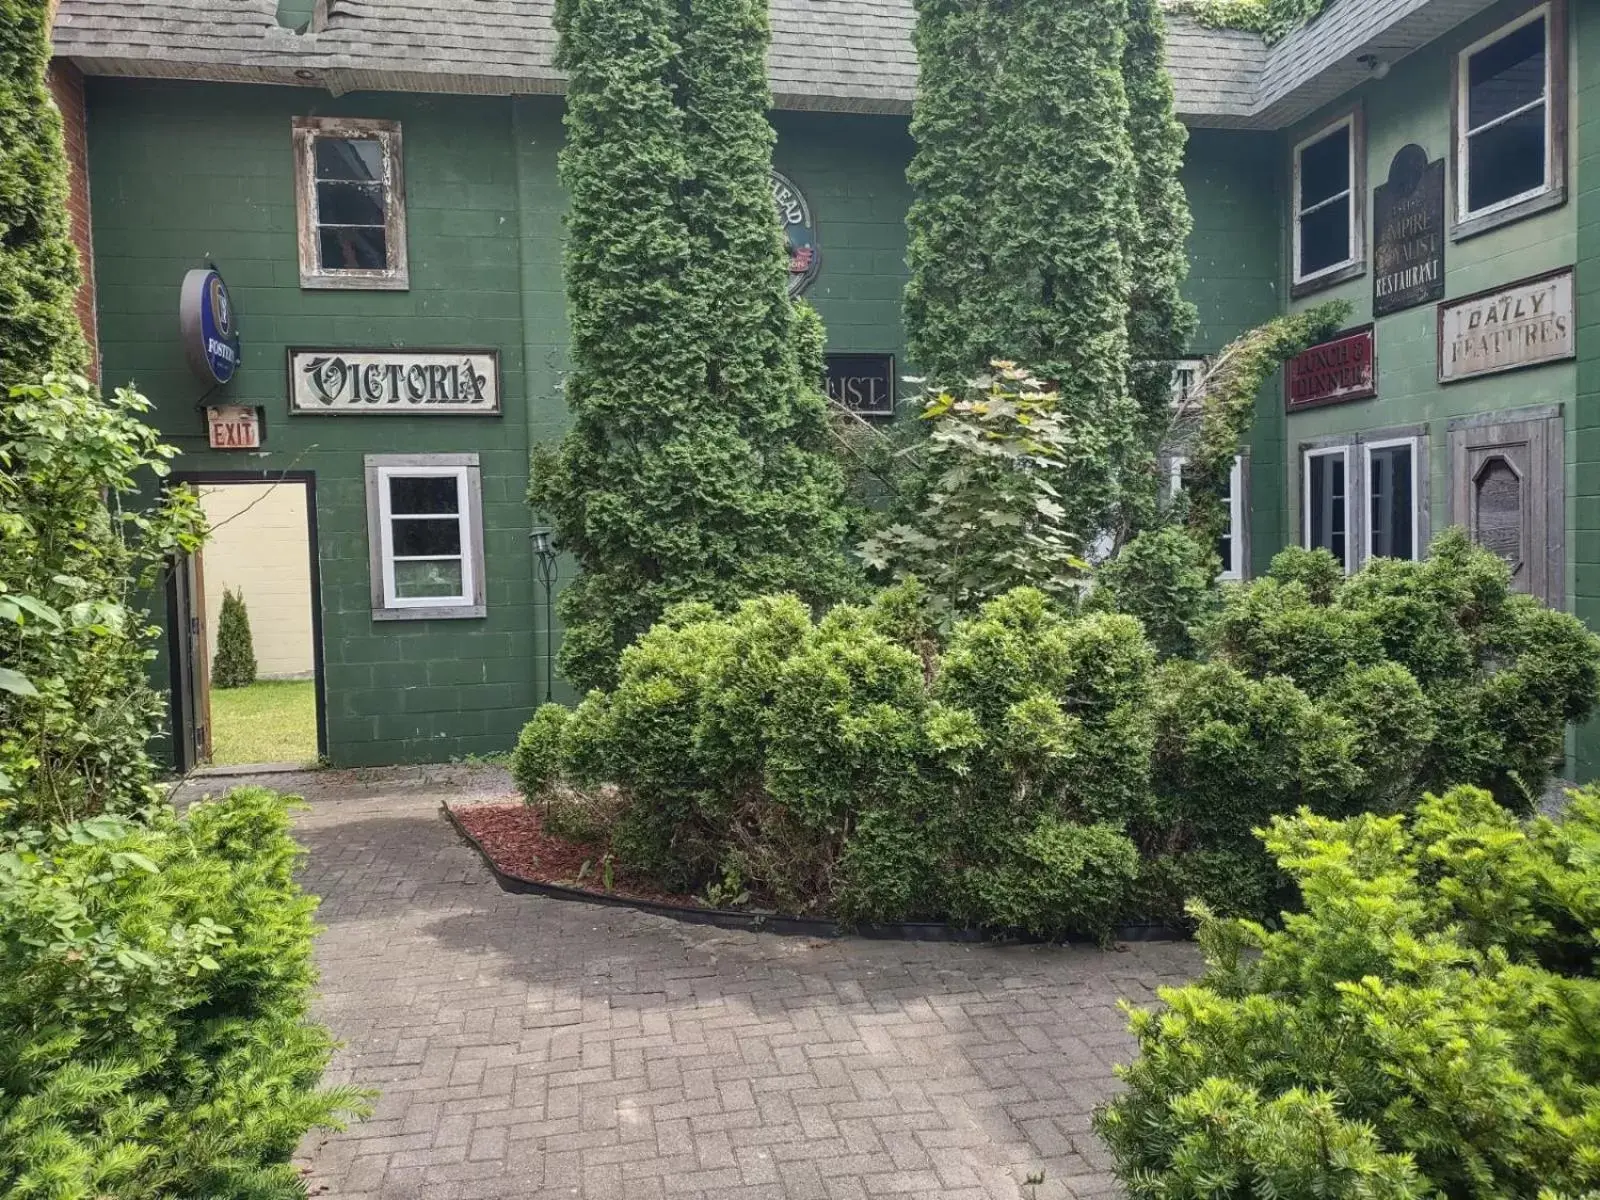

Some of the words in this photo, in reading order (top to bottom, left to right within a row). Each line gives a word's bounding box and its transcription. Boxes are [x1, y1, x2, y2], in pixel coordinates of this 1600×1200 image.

[1467, 291, 1546, 330] DAILY
[1295, 342, 1349, 375] LUNCH
[1452, 315, 1567, 363] FEATURES
[303, 356, 487, 406] VICTORIA
[214, 422, 255, 446] EXIT
